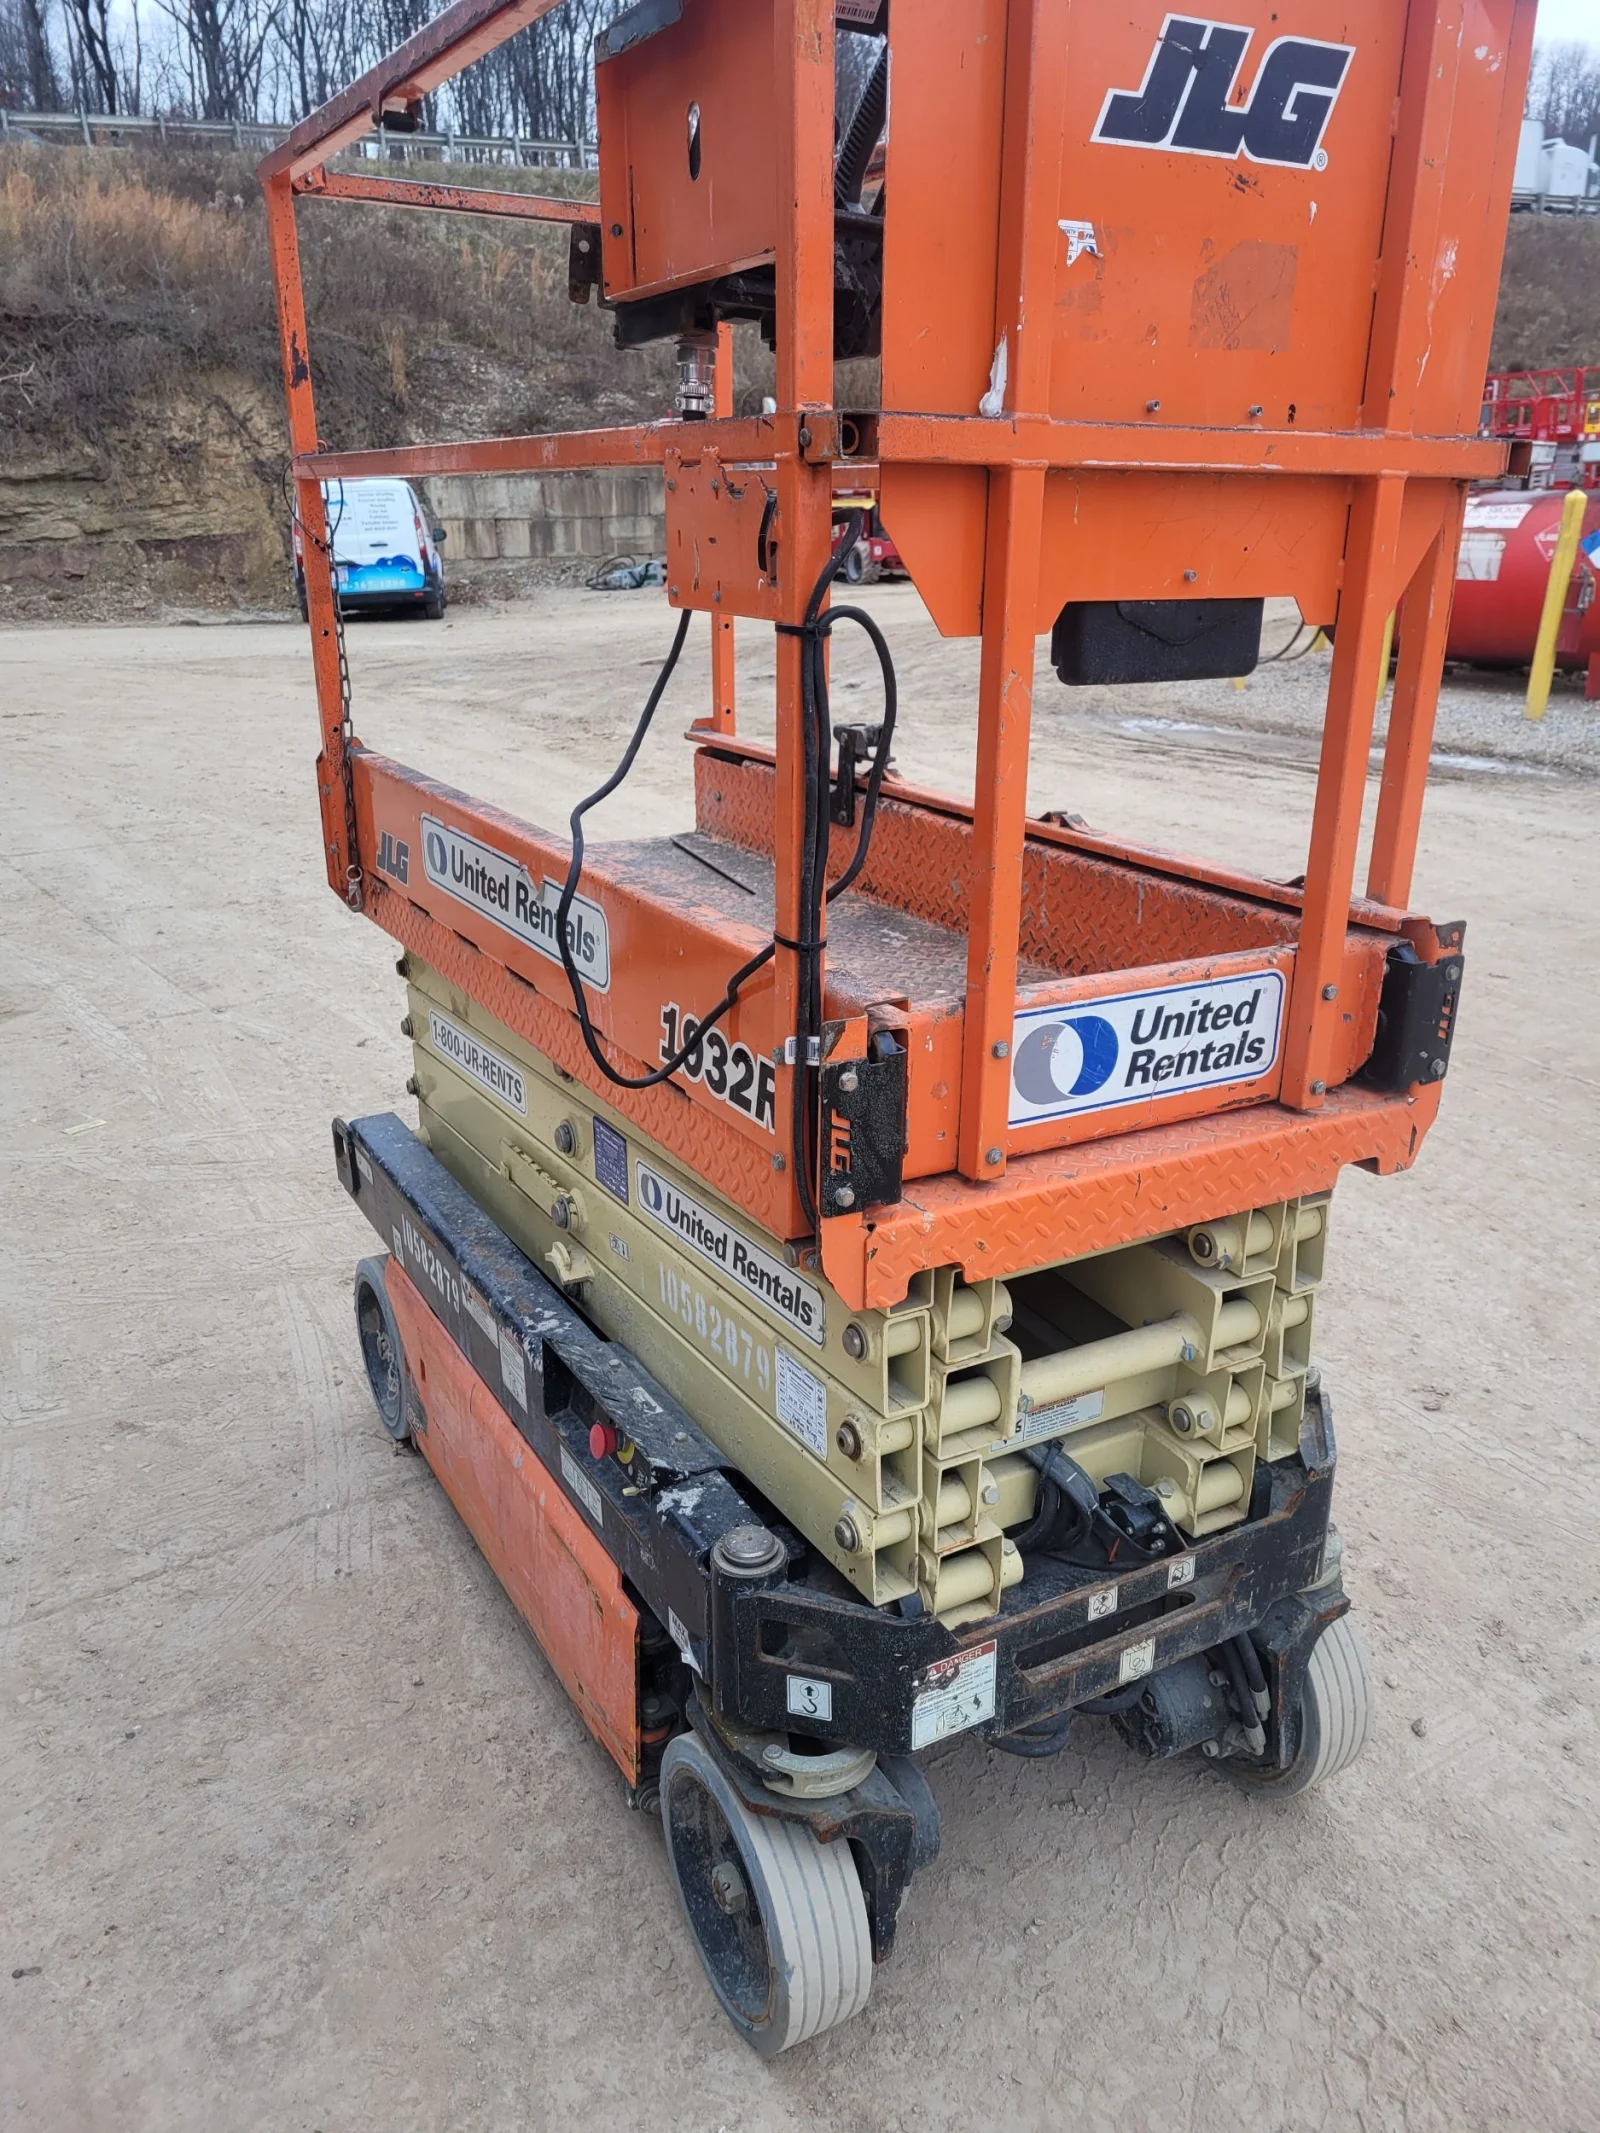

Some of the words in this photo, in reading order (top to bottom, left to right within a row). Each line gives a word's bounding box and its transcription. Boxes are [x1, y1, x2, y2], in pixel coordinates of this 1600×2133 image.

[1094, 14, 1354, 168] JLG
[376, 830, 410, 887] JLG
[451, 845, 509, 913] United
[515, 880, 596, 964] Renals
[1124, 1031, 1266, 1088] Rentals
[1130, 988, 1262, 1046] United
[433, 1019, 522, 1105] 1-800-UR-RENTS
[831, 1107, 851, 1176] JLG
[401, 1213, 460, 1314] 10582879
[666, 1191, 728, 1262] United
[733, 1240, 813, 1327] Rentals
[659, 1261, 770, 1393] 10582879
[940, 1648, 983, 1672] DANGER
